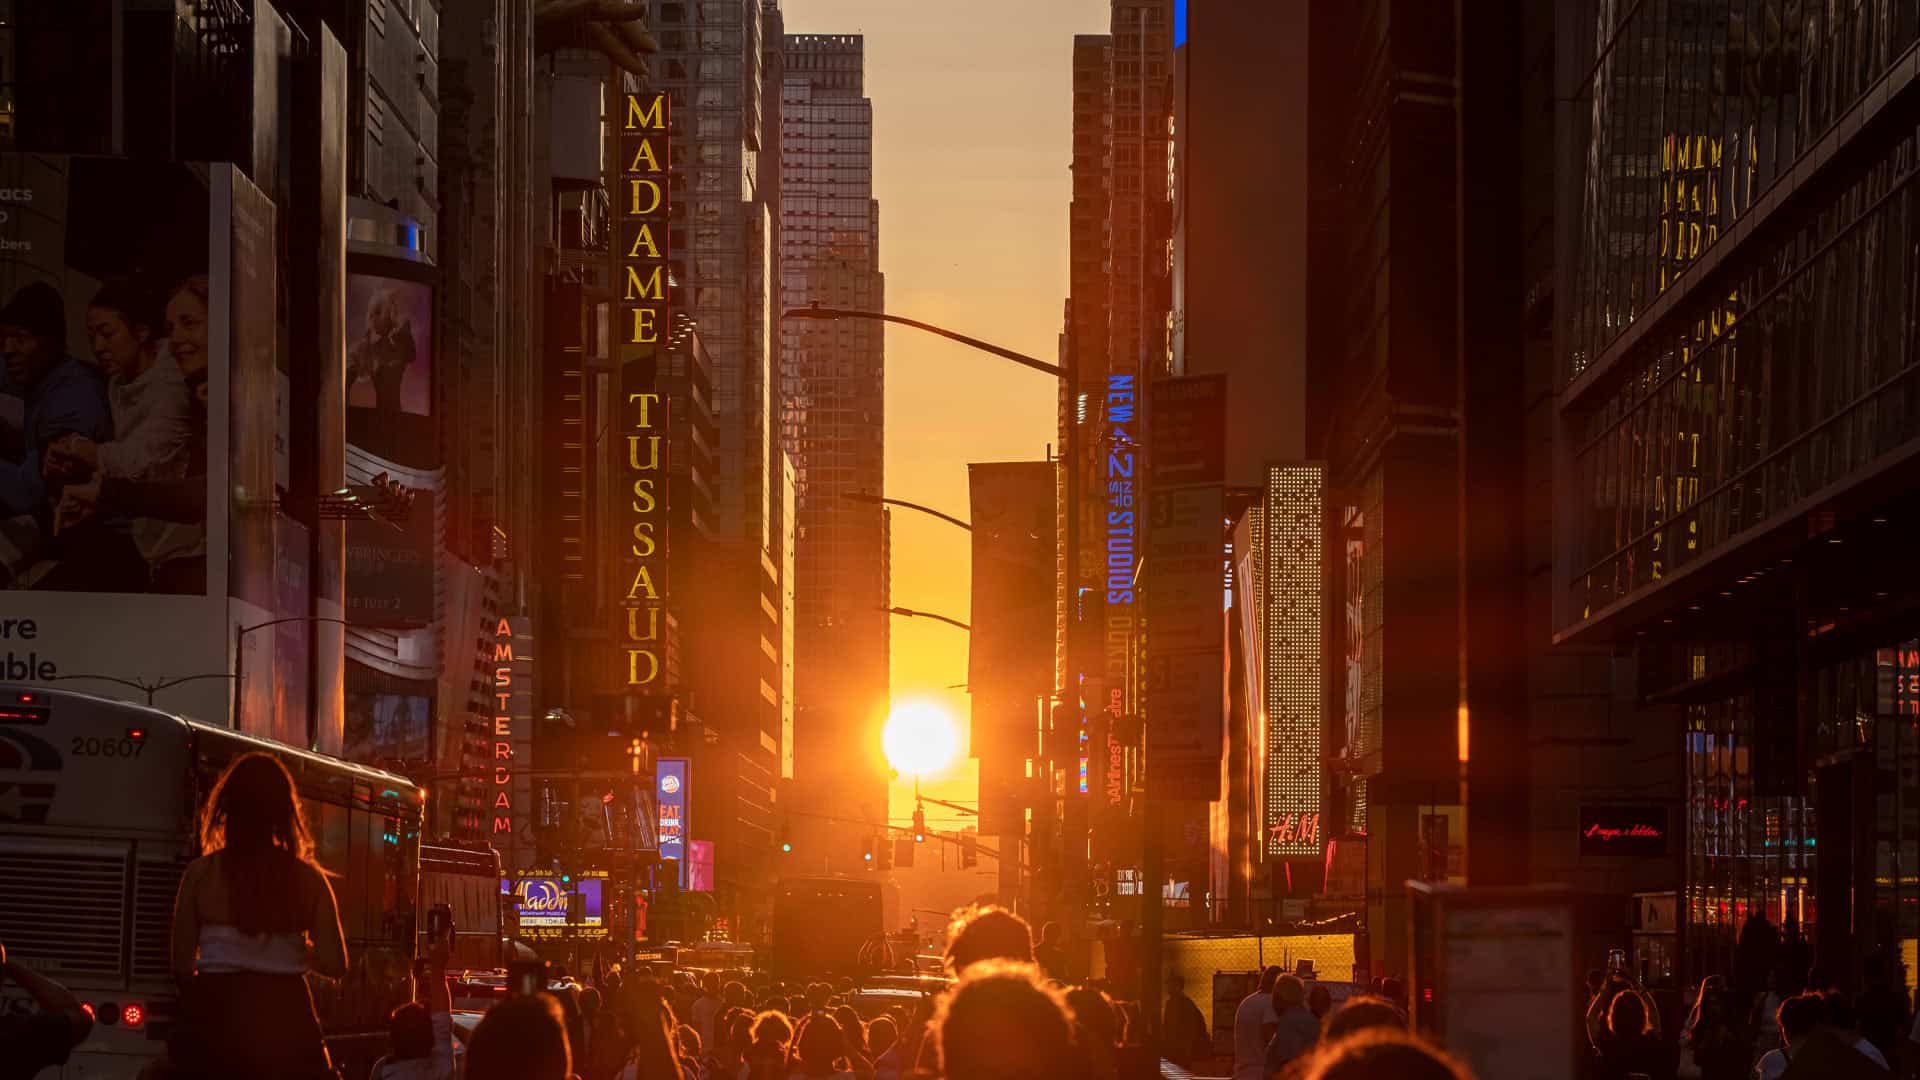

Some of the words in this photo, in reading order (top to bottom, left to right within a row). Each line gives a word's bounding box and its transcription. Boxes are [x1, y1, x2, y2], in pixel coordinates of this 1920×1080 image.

[624, 95, 666, 343] MADAME
[1107, 375, 1135, 423] NEW
[626, 393, 662, 685] TUSSAUD
[1107, 511, 1135, 604] STUDIOS
[71, 736, 145, 758] 20607
[493, 616, 513, 833] AMSTERDAM
[1268, 812, 1320, 845] H&M
